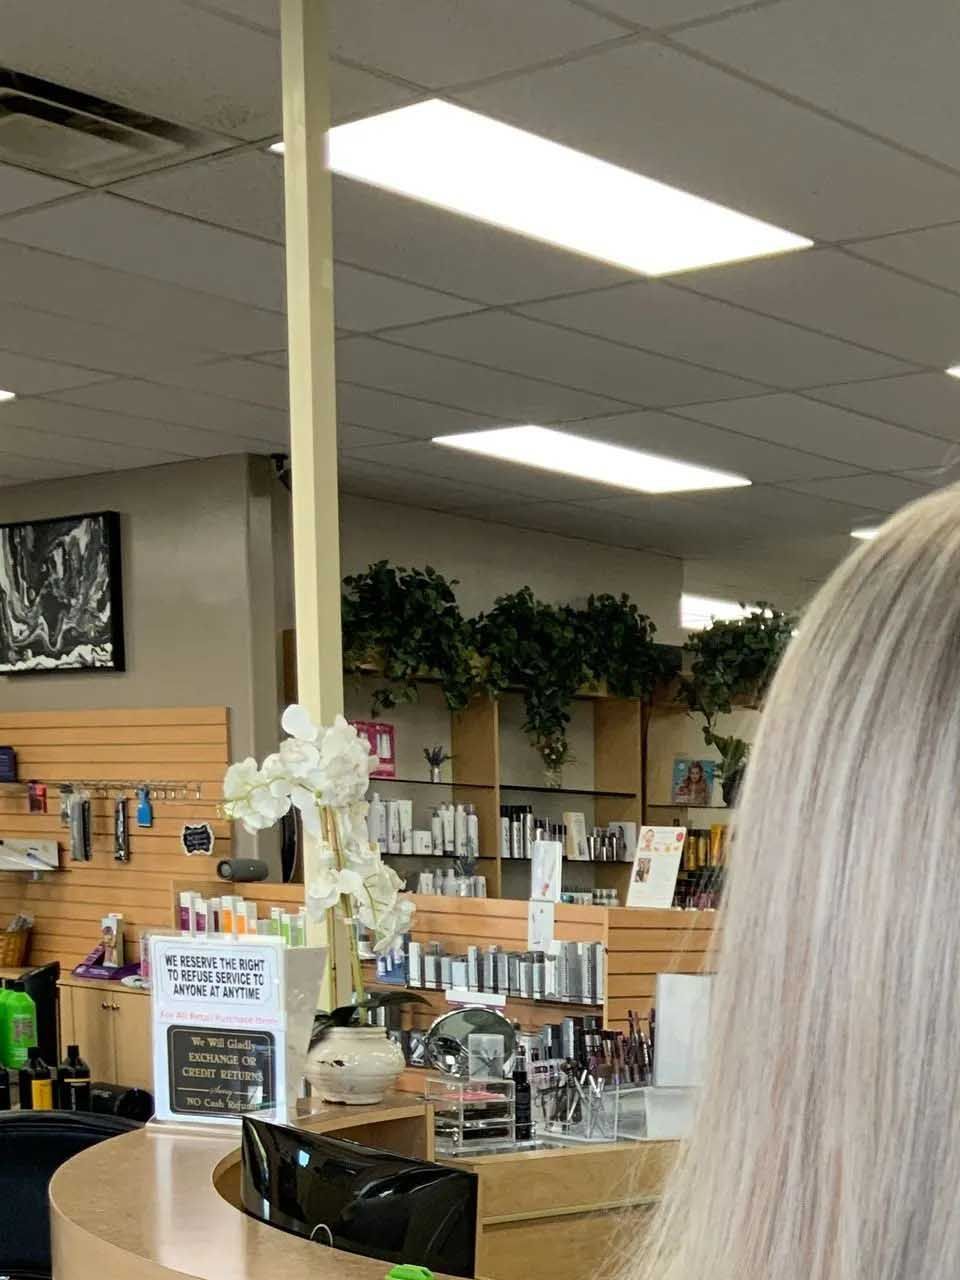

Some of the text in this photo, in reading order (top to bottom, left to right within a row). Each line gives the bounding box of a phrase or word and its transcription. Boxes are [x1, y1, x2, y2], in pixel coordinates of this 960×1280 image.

[165, 954, 265, 972] WE RESERVE THE RIGHT
[168, 968, 265, 986] TO REFUSE SERVICE TO
[173, 984, 261, 1000] ANYONE AT ANYTIME
[191, 1036, 256, 1052] We Will Gladly
[188, 1052, 257, 1066] EXCHANGE OR
[182, 1066, 264, 1081] CREDIT RETURNS
[204, 1097, 225, 1108] Cash
[228, 1099, 261, 1110] Refun
